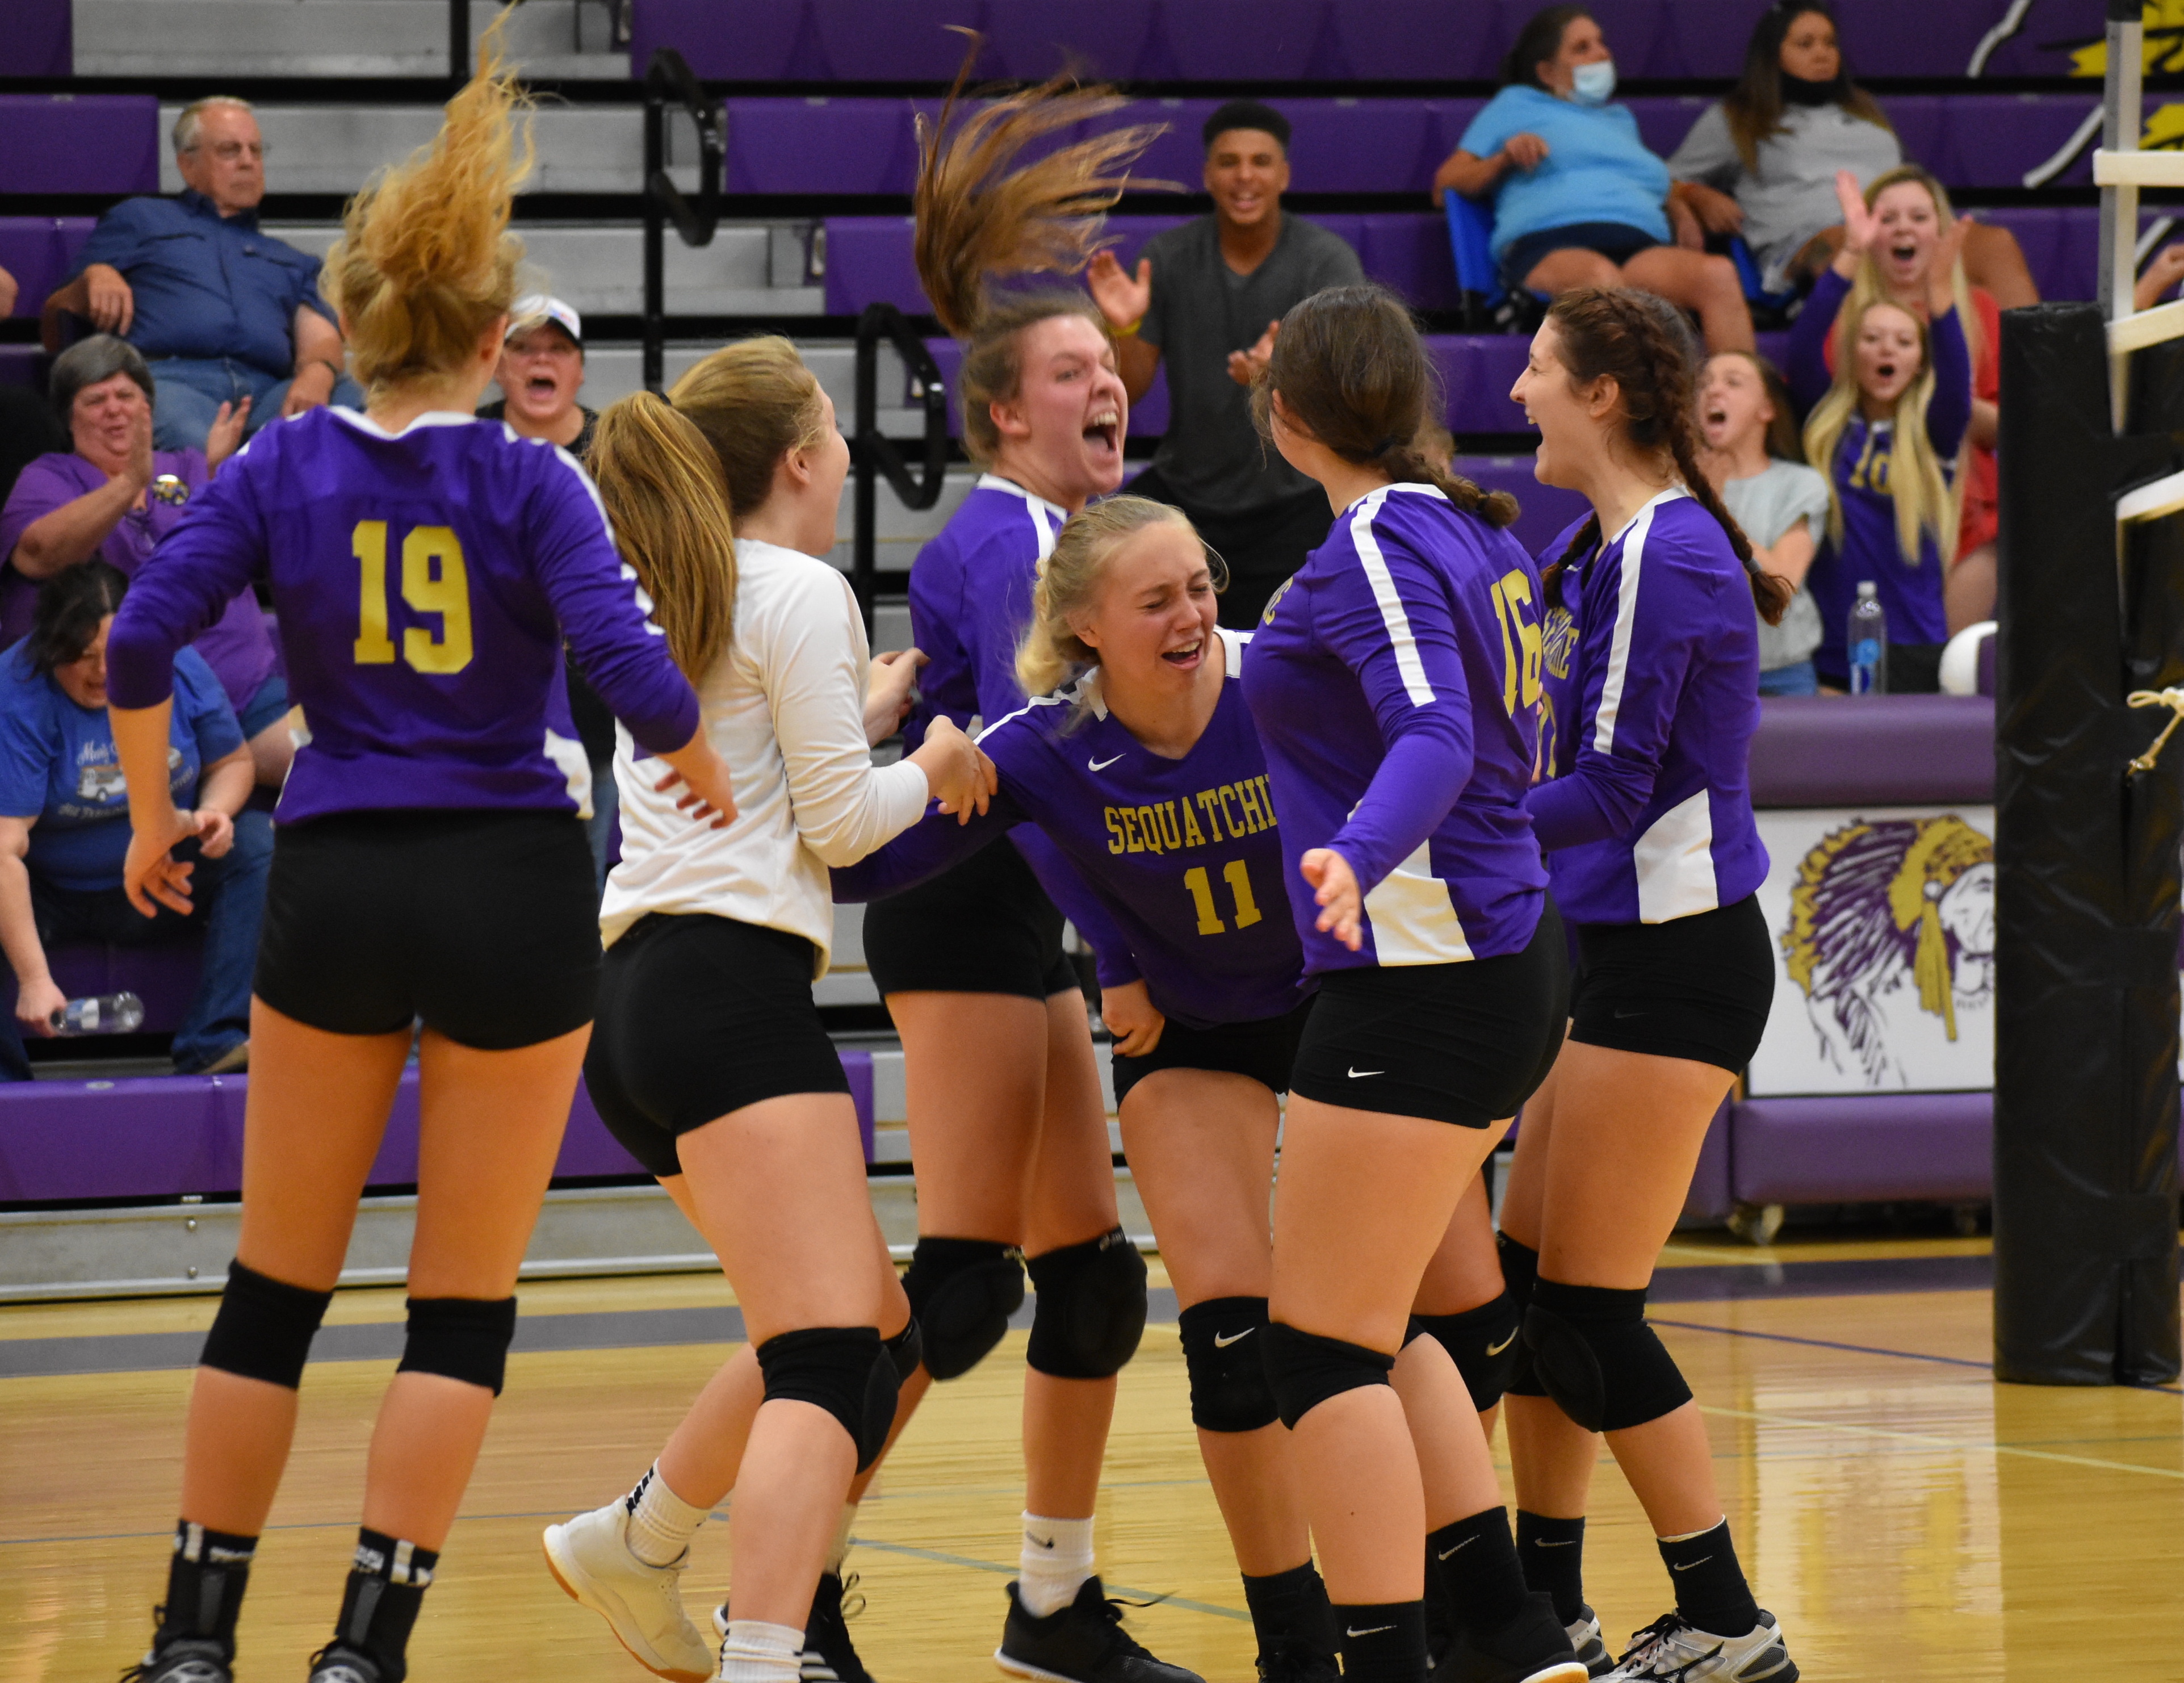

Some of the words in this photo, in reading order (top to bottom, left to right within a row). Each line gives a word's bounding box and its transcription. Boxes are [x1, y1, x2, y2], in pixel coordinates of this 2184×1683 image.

[351, 519, 473, 674] 19
[1490, 568, 1542, 719] 16
[1104, 773, 1277, 855] SEQUATCHI
[1184, 859, 1262, 936] 11
